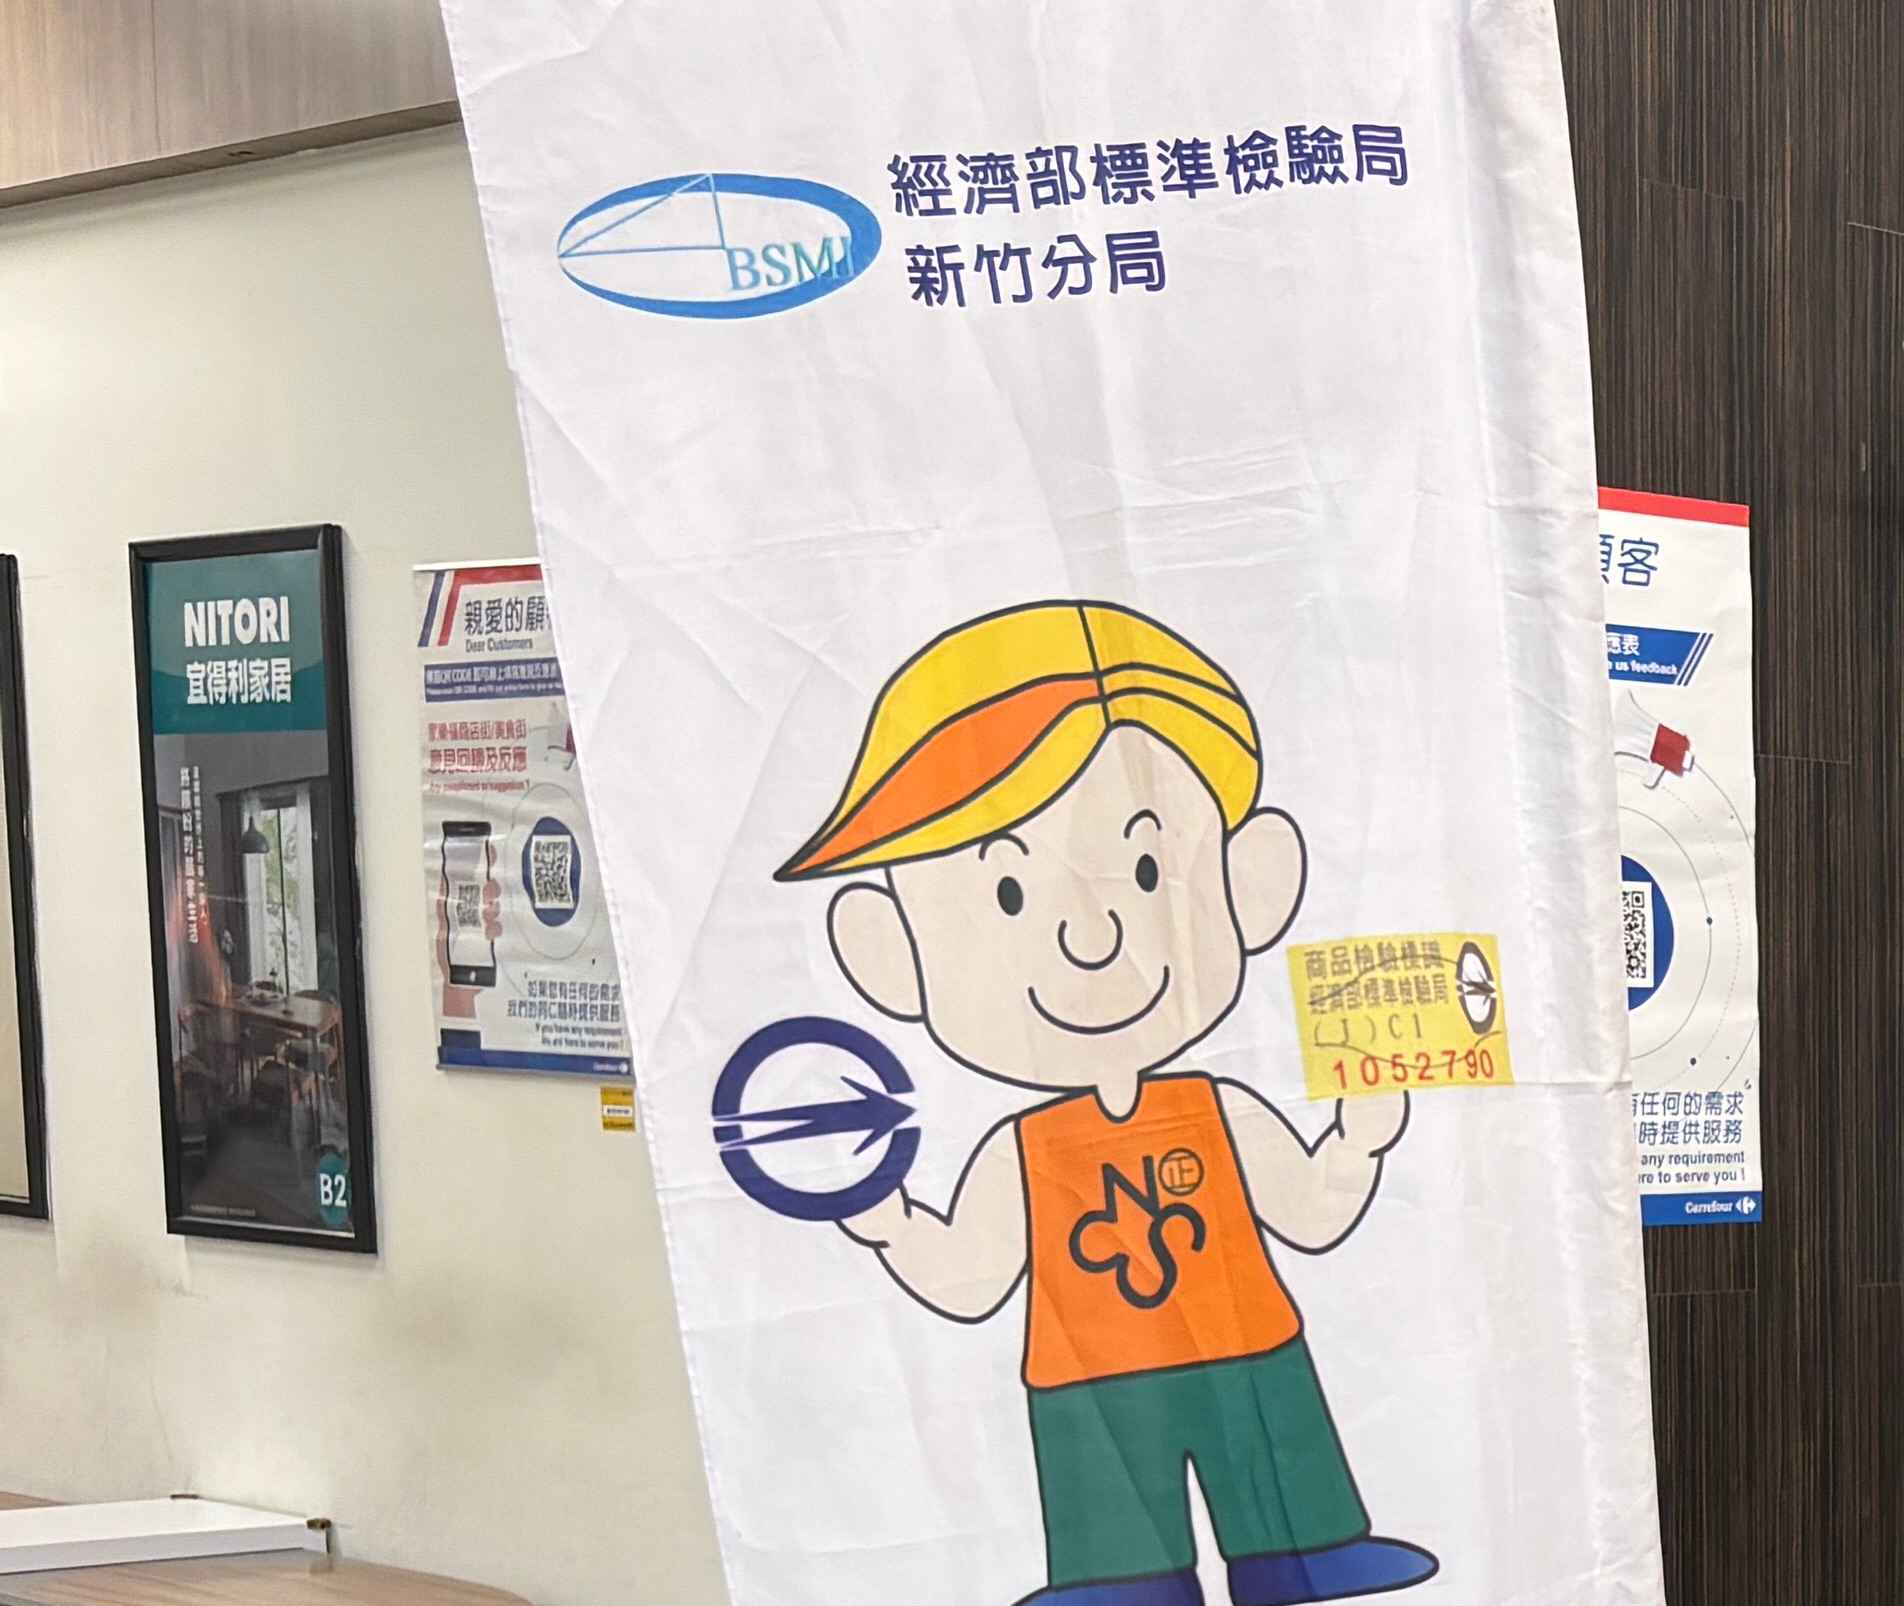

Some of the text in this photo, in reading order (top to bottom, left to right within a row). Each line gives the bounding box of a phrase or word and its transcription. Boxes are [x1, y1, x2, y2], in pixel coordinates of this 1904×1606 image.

[887, 123, 1409, 220] 經濟部標準檢驗局
[727, 235, 856, 292] BSMI
[904, 231, 1168, 309] 新竹分局
[184, 596, 290, 648] NITORI
[464, 595, 550, 635] 親愛的顧
[186, 657, 292, 705] 宜得利家居
[1631, 660, 1678, 676] feedback
[1333, 1048, 1495, 1089] 1052790
[1632, 1091, 1744, 1117] 任何的需求
[1638, 1120, 1743, 1146] 時提供服務
[1641, 1151, 1745, 1168] any requirement
[319, 1173, 348, 1208] B2
[1658, 1171, 1671, 1184] to
[1676, 1173, 1710, 1184] serve
[1714, 1172, 1738, 1186] you
[1684, 1201, 1733, 1214] Carrefour
